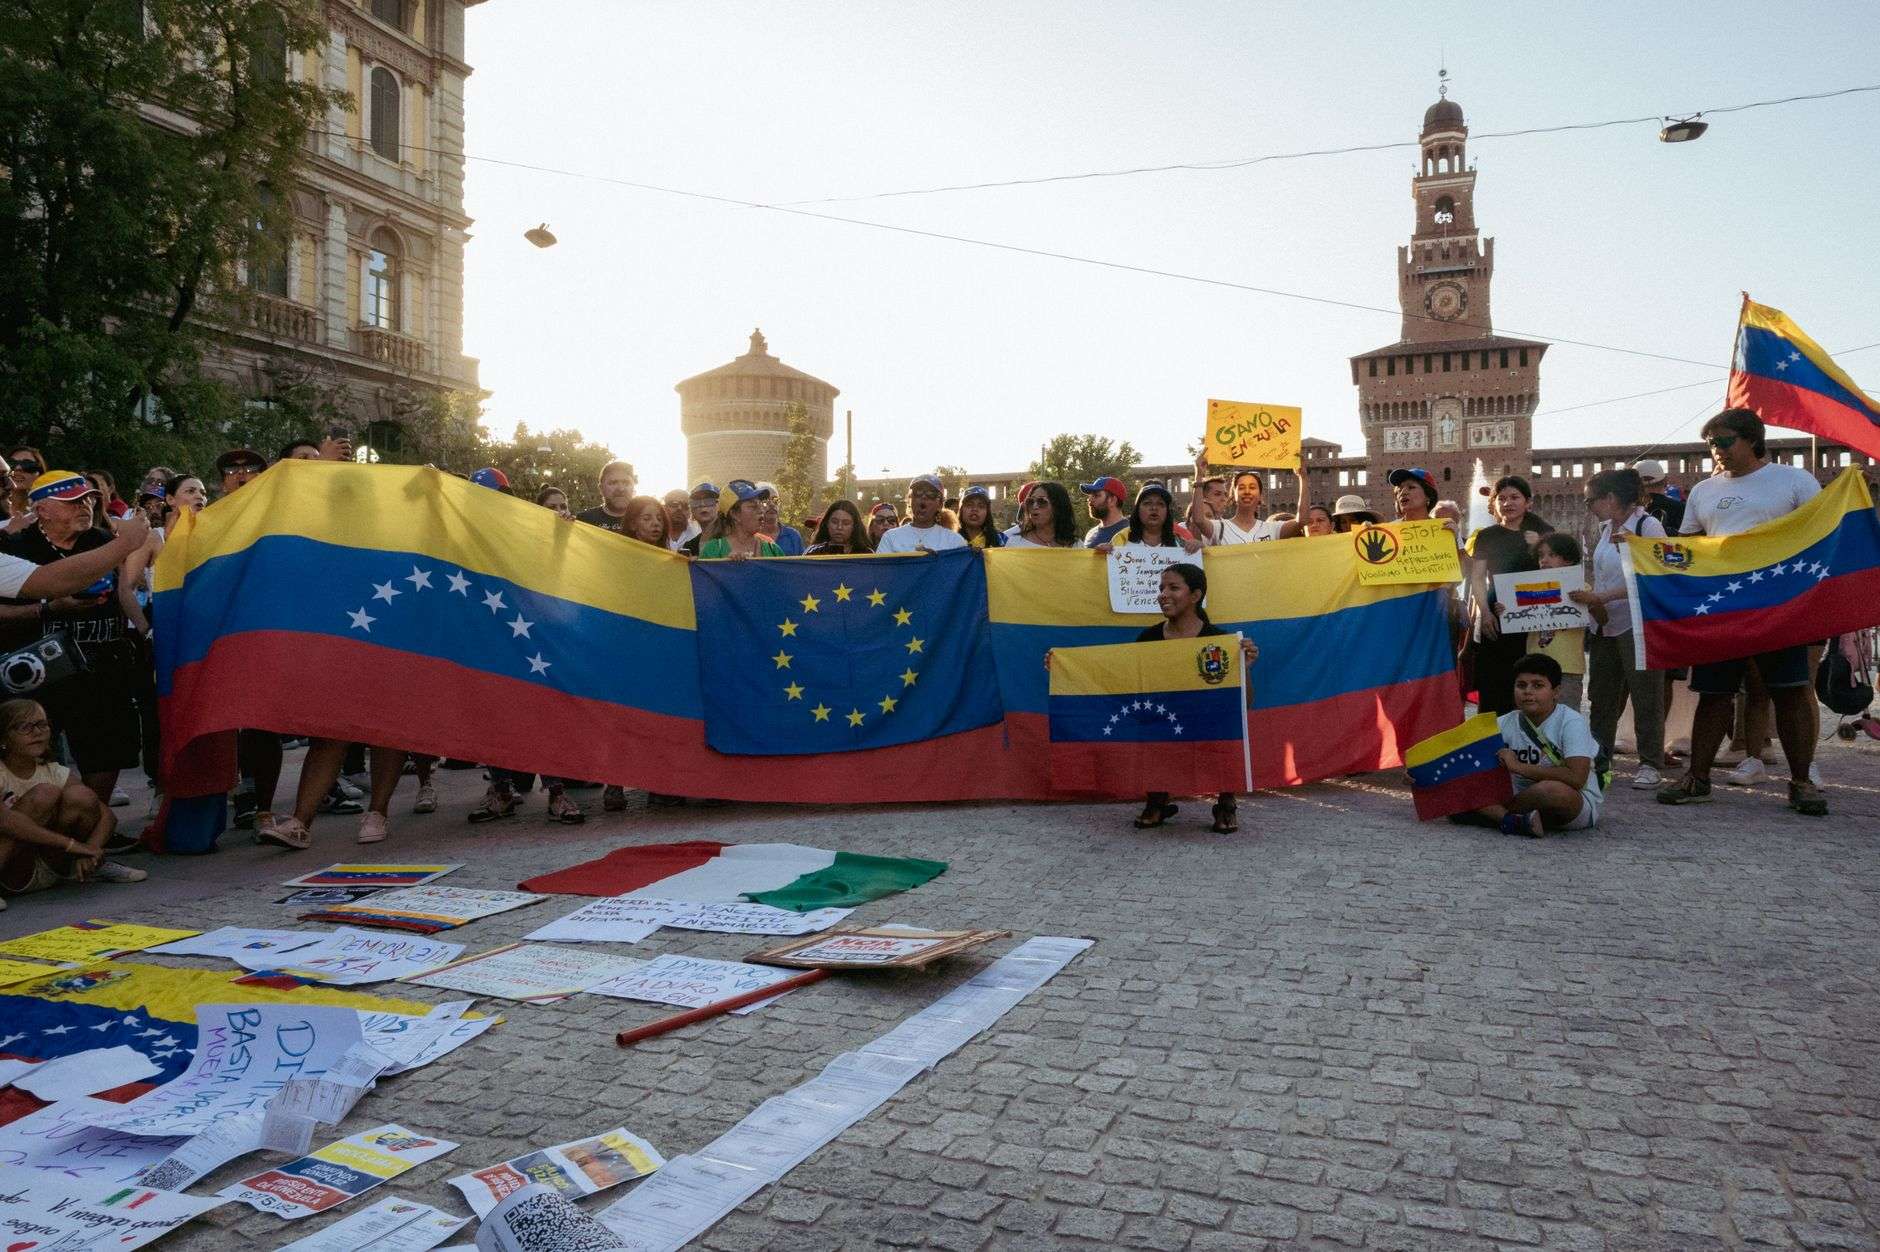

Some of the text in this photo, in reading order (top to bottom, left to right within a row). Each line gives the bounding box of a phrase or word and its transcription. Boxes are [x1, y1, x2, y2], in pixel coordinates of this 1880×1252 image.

[1399, 524, 1441, 541] STOP
[600, 976, 719, 995] MADURO
[211, 1008, 262, 1085] BASTA
